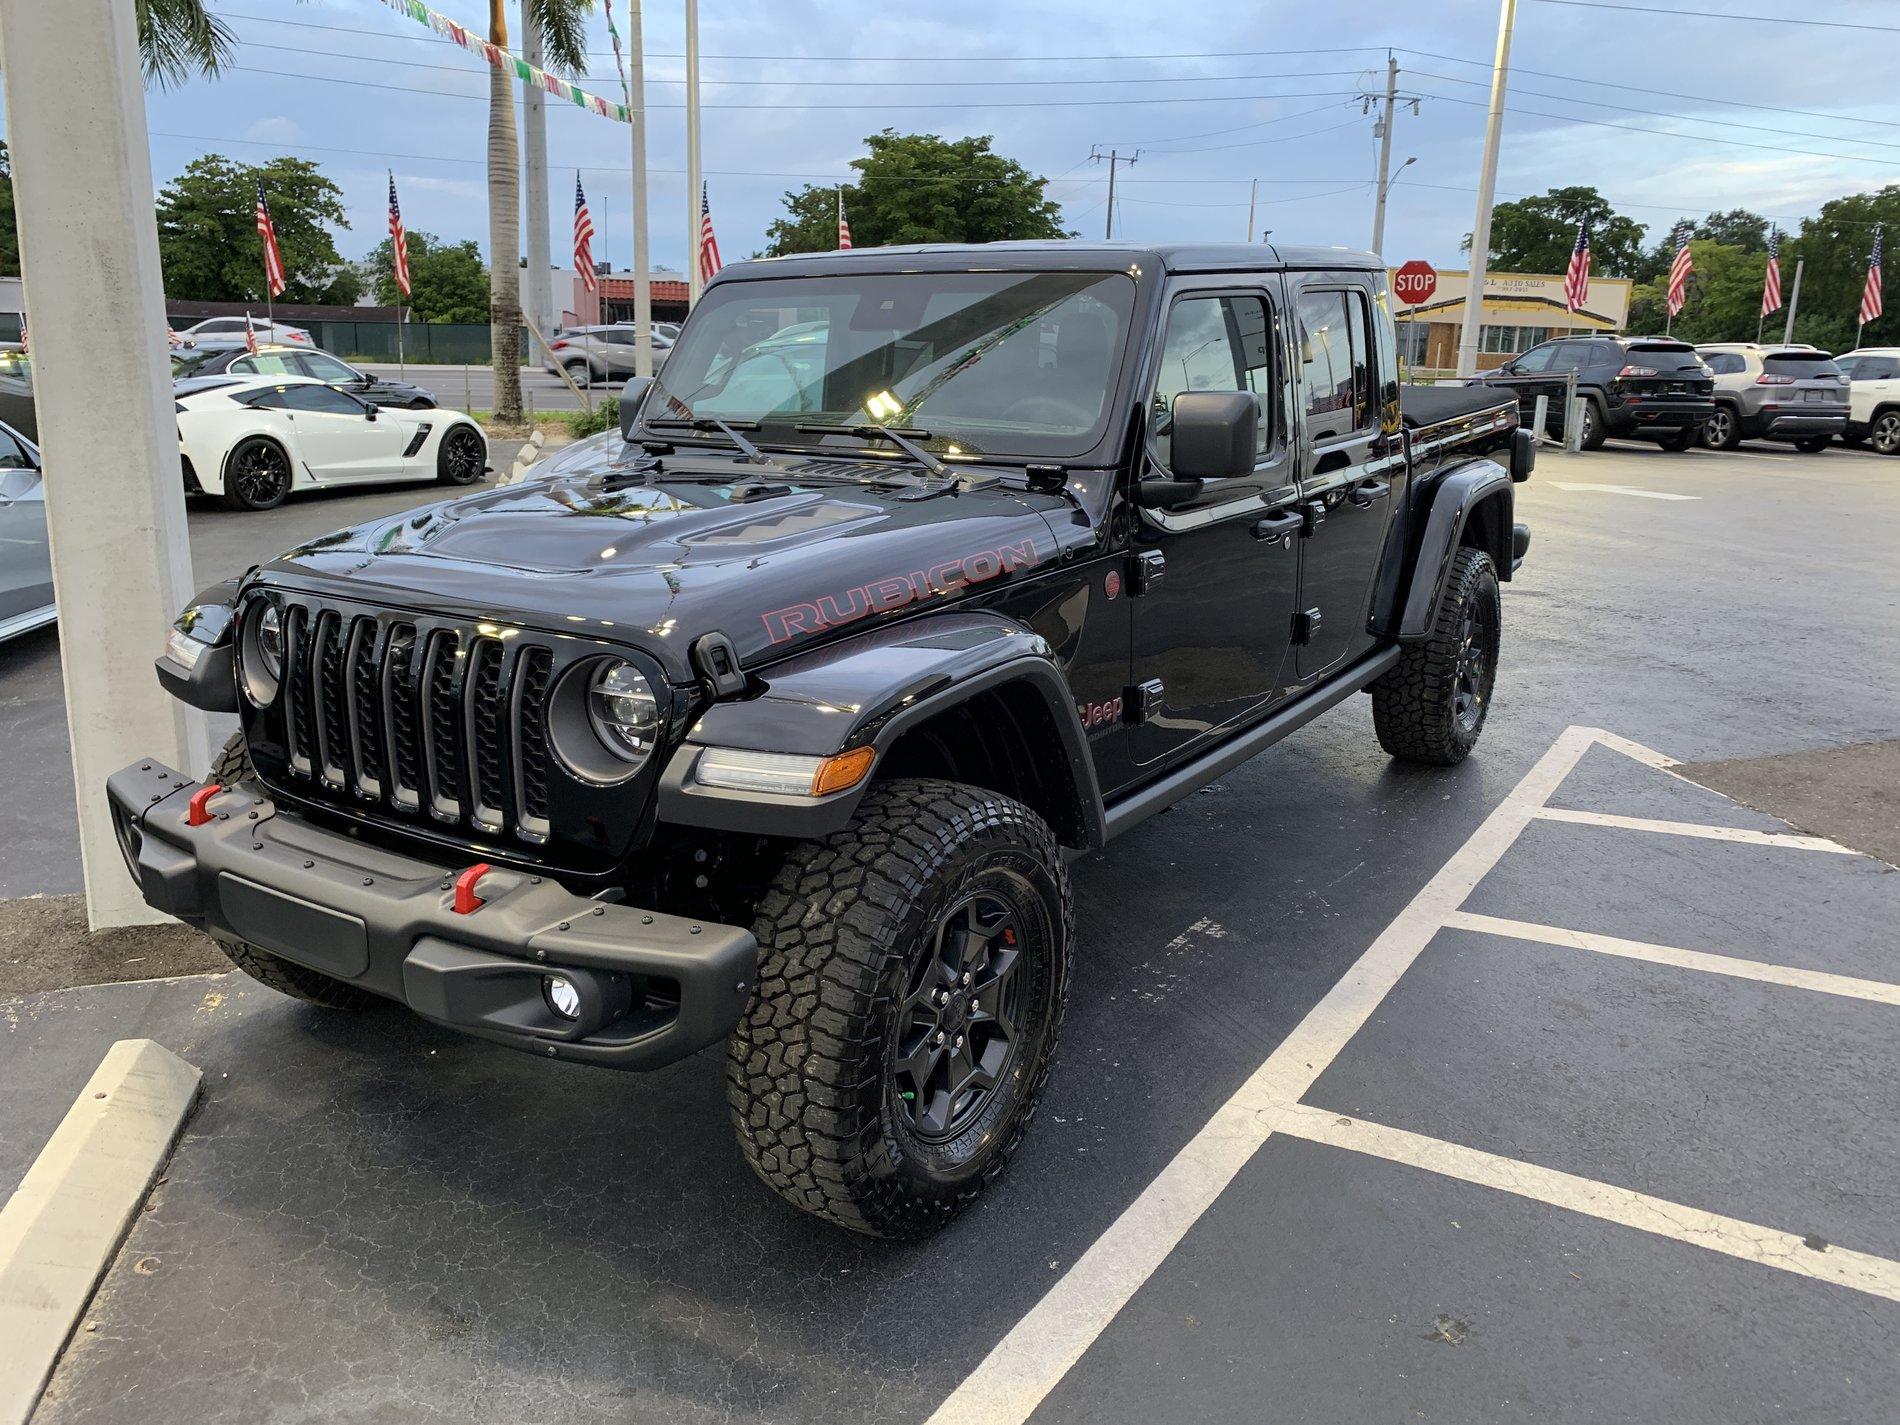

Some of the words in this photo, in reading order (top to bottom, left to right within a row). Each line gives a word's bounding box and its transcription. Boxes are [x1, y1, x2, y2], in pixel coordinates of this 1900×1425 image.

[1396, 274, 1434, 291] STOP
[1502, 279, 1524, 287] AUTO
[1525, 280, 1546, 288] SALES
[761, 538, 1039, 644] RUBICON
[1081, 696, 1123, 730] Jeep
